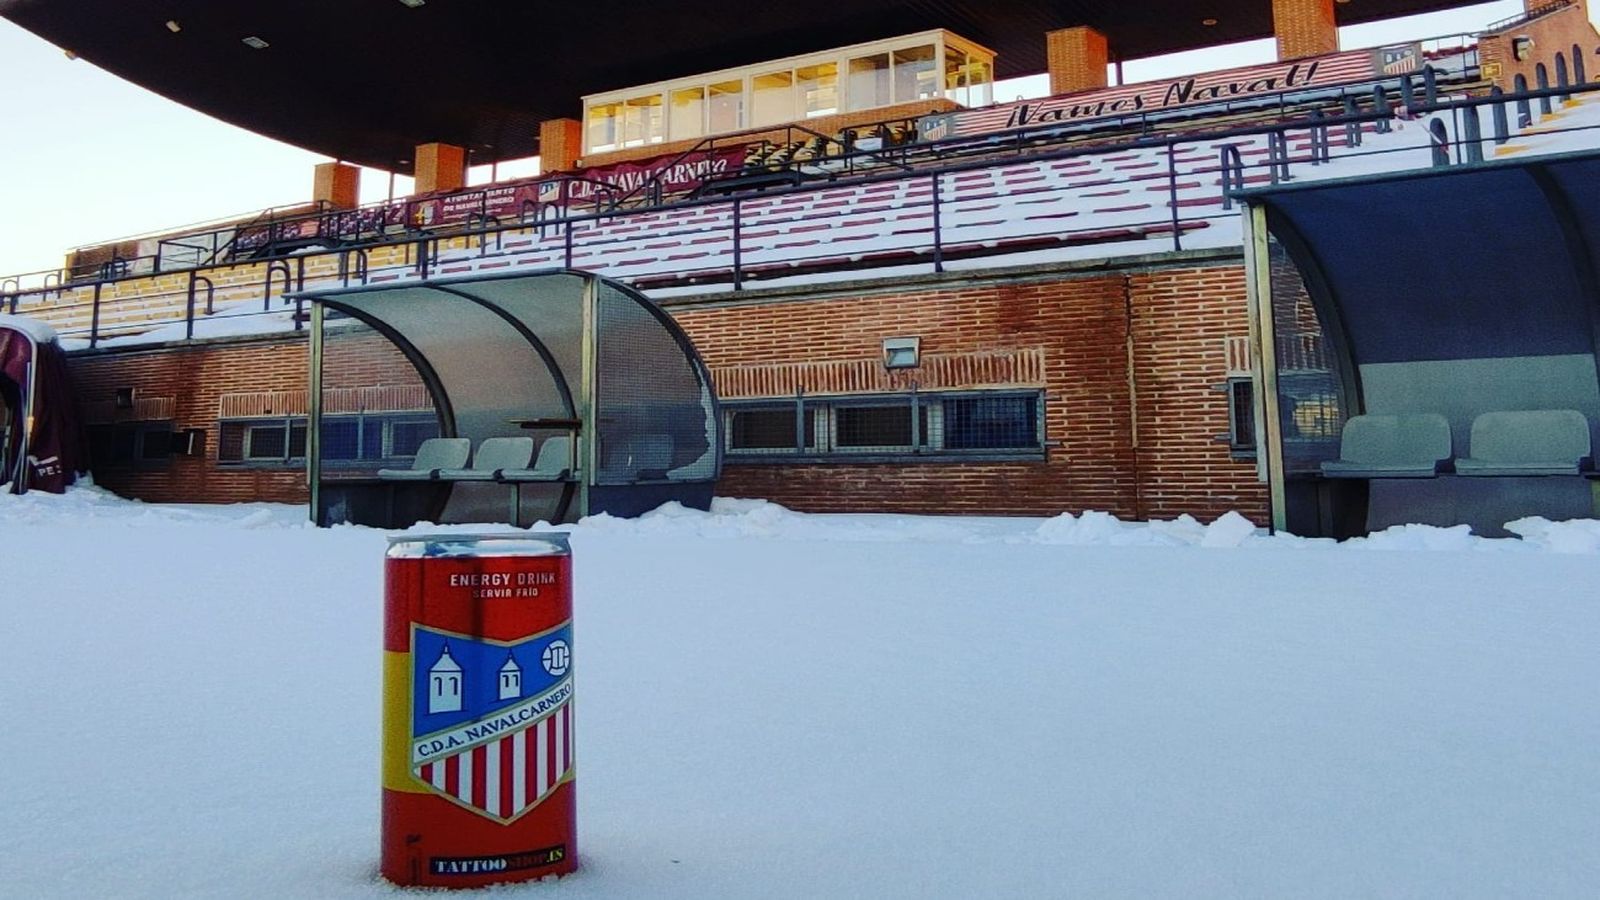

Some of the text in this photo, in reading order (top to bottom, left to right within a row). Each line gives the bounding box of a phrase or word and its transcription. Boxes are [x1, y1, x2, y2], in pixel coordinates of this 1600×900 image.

[1162, 61, 1320, 107] Naval!
[450, 572, 556, 587] ENERGY DRINK
[473, 589, 512, 598] SERVIR
[418, 684, 571, 757] C.D.A. NAVALCARNERO
